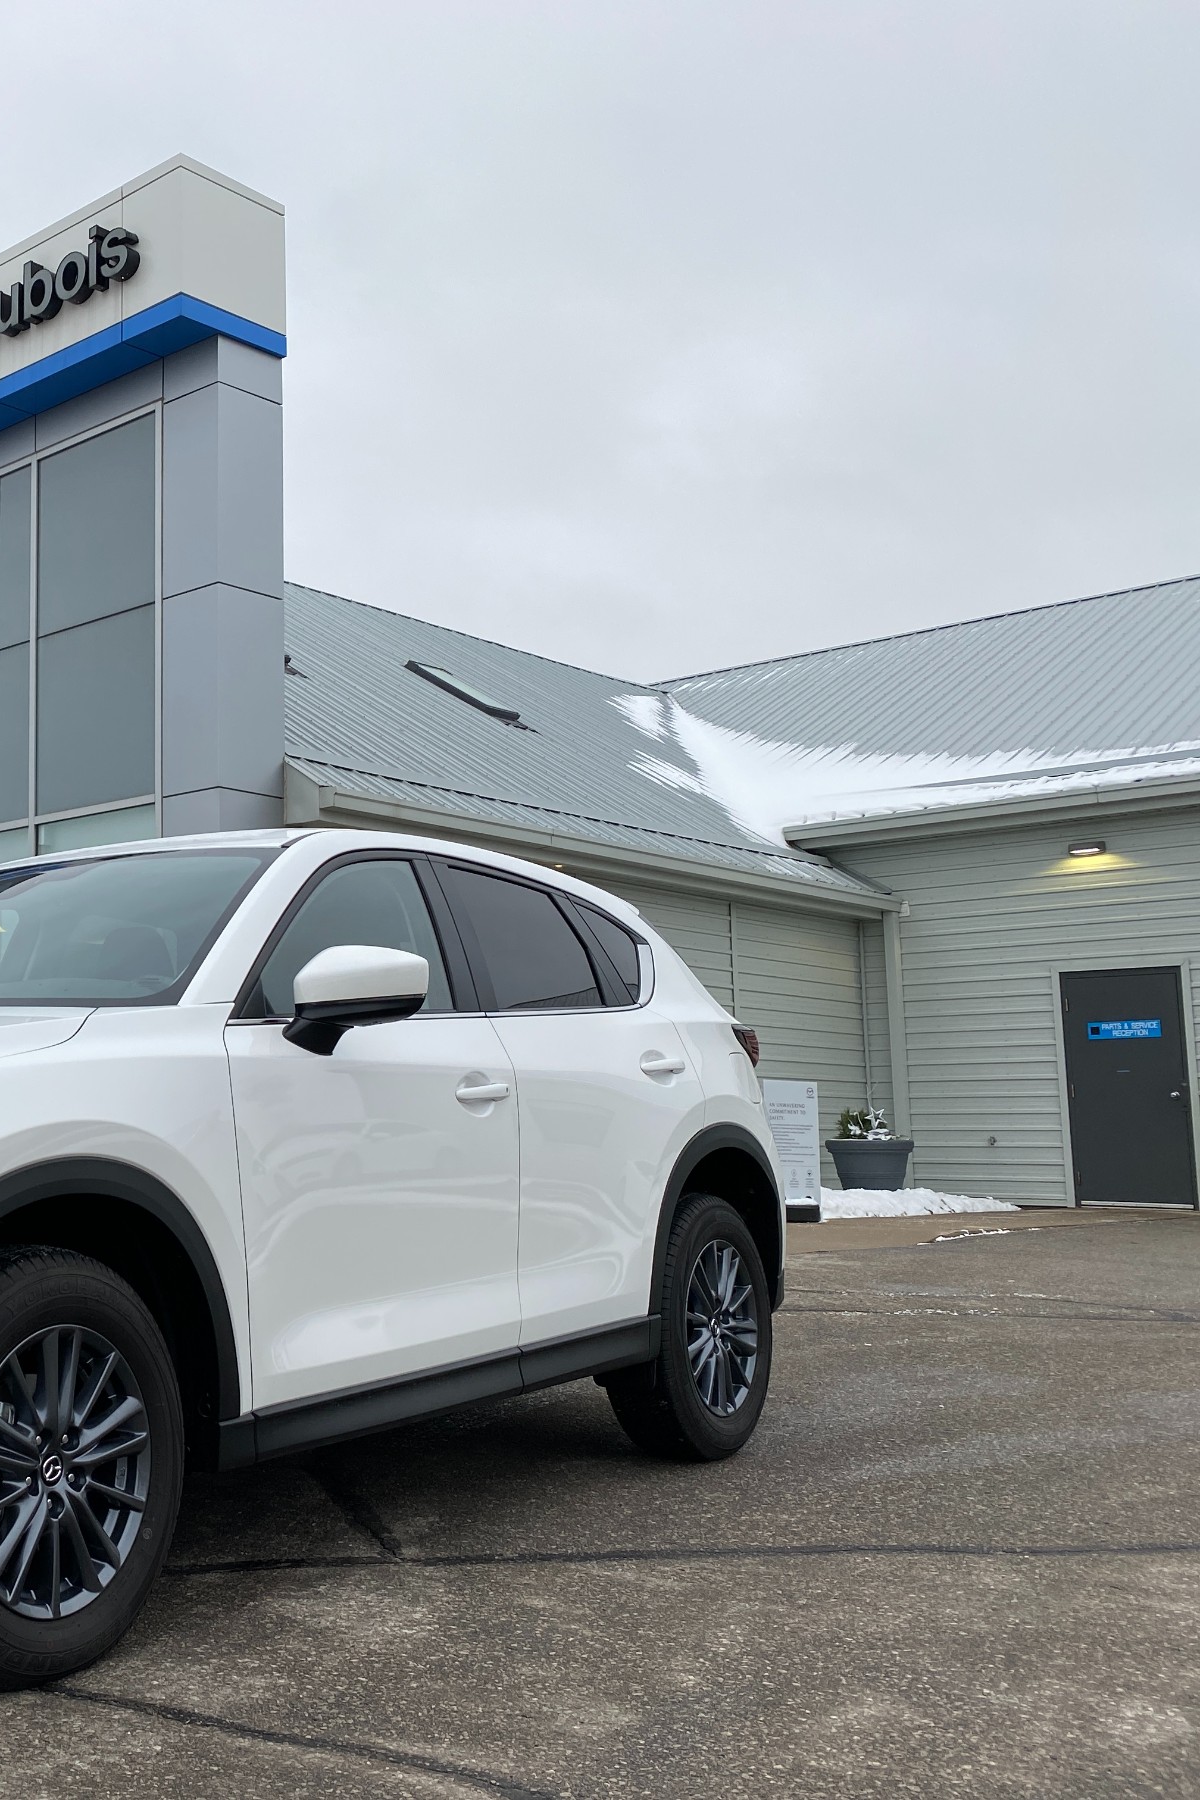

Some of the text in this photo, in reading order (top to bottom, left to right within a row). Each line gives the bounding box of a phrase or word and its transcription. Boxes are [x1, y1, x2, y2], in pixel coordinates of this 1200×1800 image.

[1101, 1022, 1122, 1031] PARTS
[1131, 1021, 1159, 1030] SERVICE
[1112, 1029, 1149, 1037] RECEPTION
